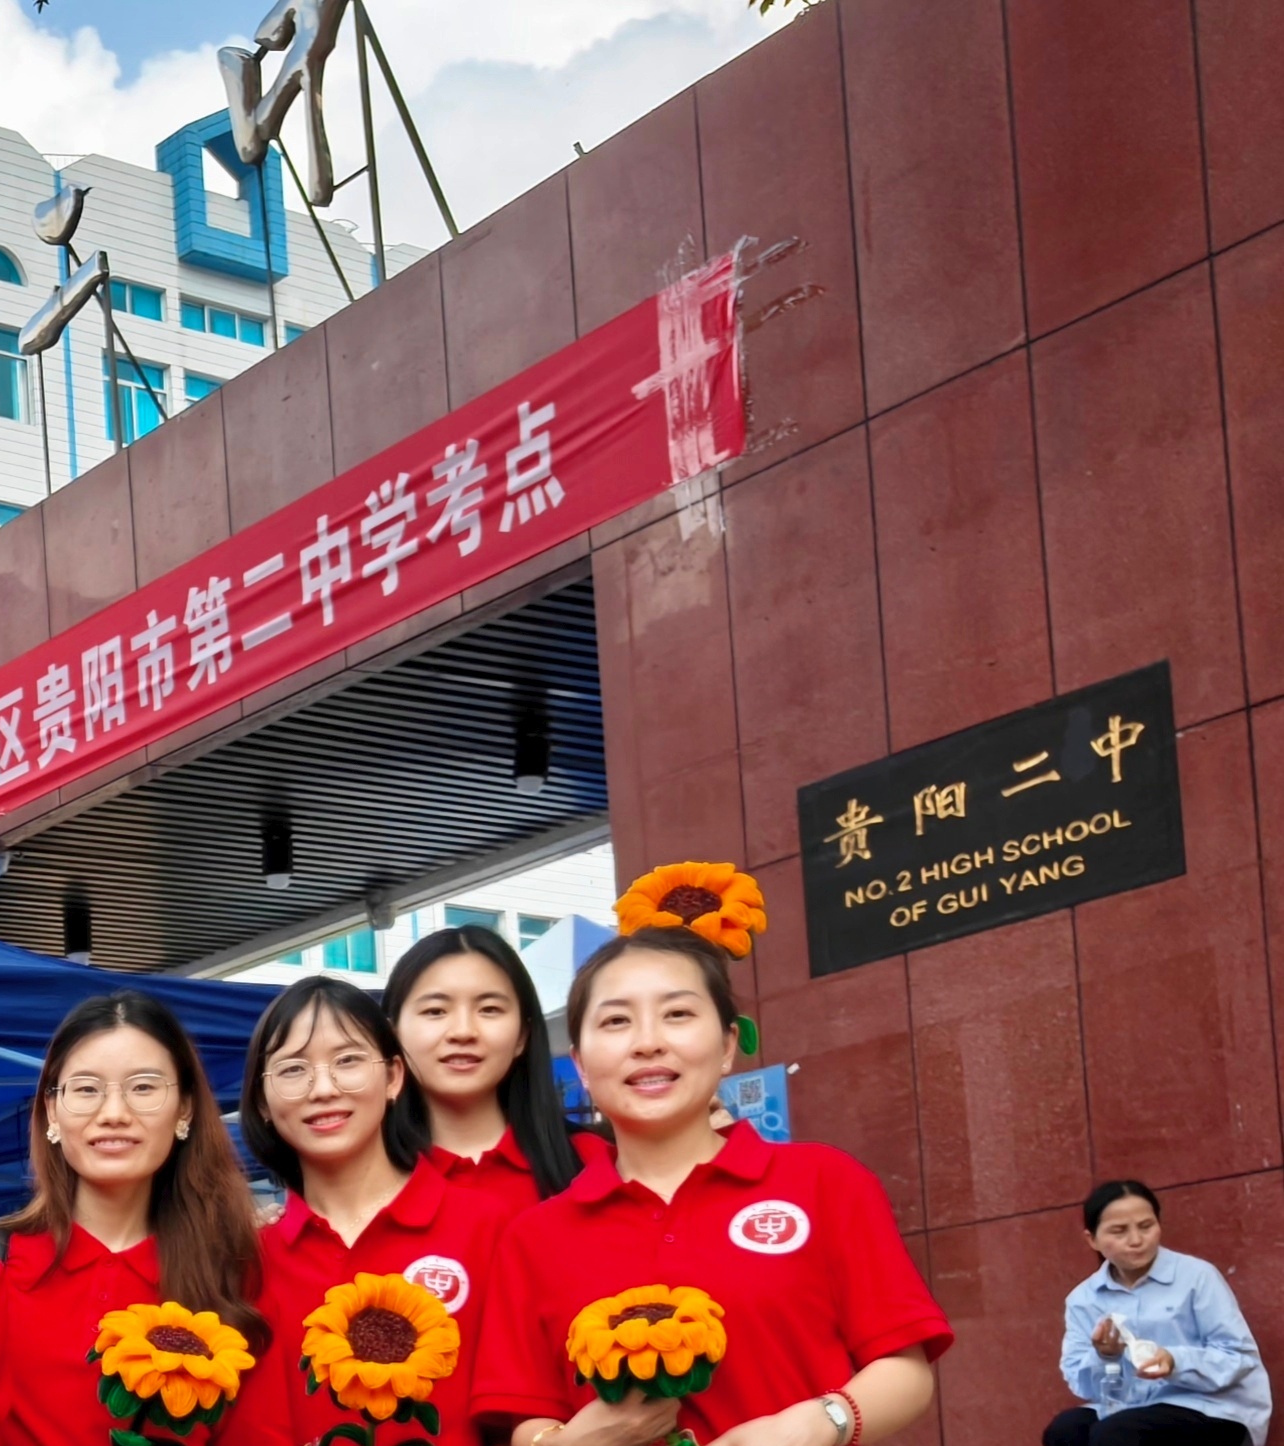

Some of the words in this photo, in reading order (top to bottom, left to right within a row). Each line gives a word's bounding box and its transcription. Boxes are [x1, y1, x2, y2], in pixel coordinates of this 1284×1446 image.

[824, 715, 1145, 868] 贵阳二中
[920, 847, 995, 884] HIGH
[1002, 809, 1132, 863] SCHOOL
[889, 904, 927, 927] OF
[936, 884, 988, 915] GUI
[999, 855, 1086, 895] YANG
